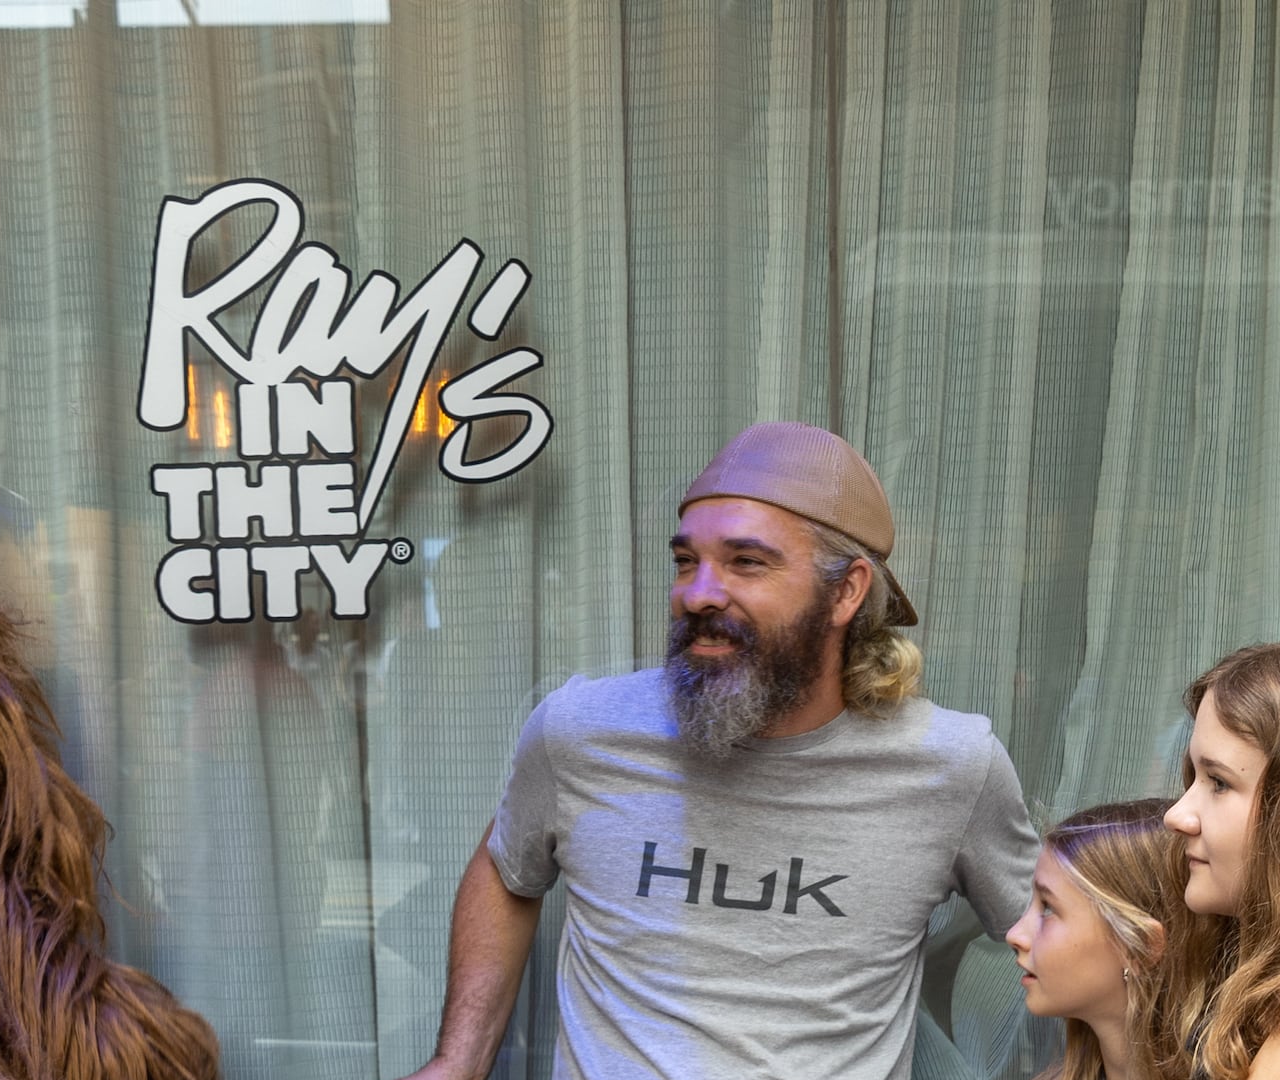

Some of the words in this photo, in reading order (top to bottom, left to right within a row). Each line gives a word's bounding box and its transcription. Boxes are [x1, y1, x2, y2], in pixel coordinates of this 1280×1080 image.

[137, 177, 554, 536] Ray's
[236, 376, 356, 460] IN
[151, 462, 361, 543] THE
